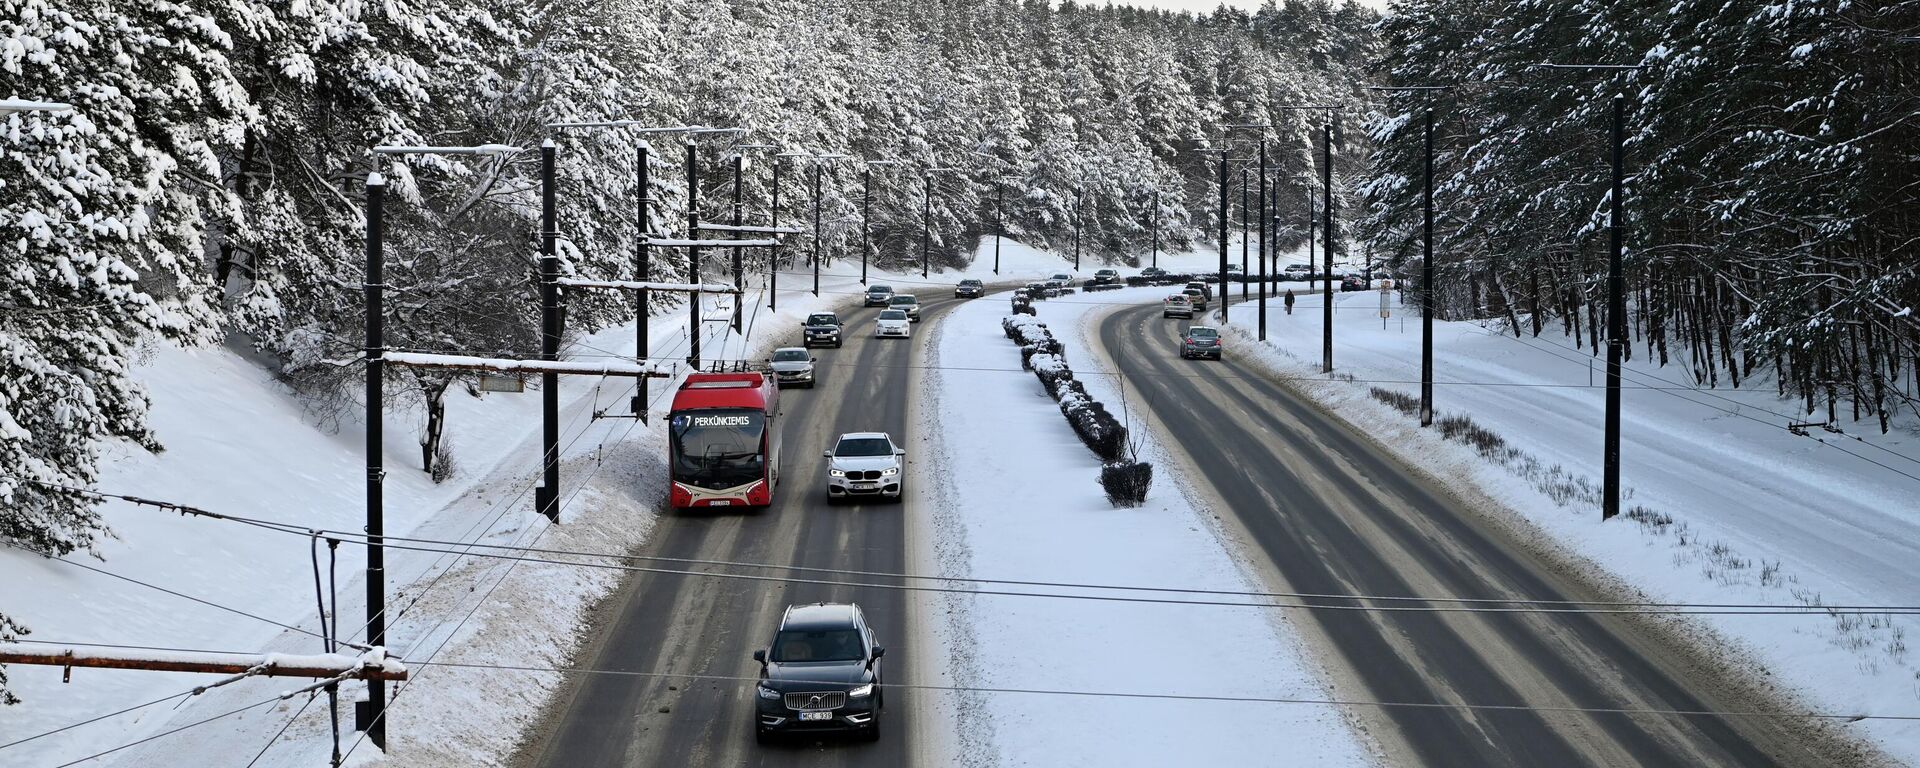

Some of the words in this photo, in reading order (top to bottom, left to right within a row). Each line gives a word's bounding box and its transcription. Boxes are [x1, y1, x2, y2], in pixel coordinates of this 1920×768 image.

[685, 415, 691, 427] 7
[694, 415, 750, 426] PERKŪNKIEMIS
[819, 711, 832, 719] 939
